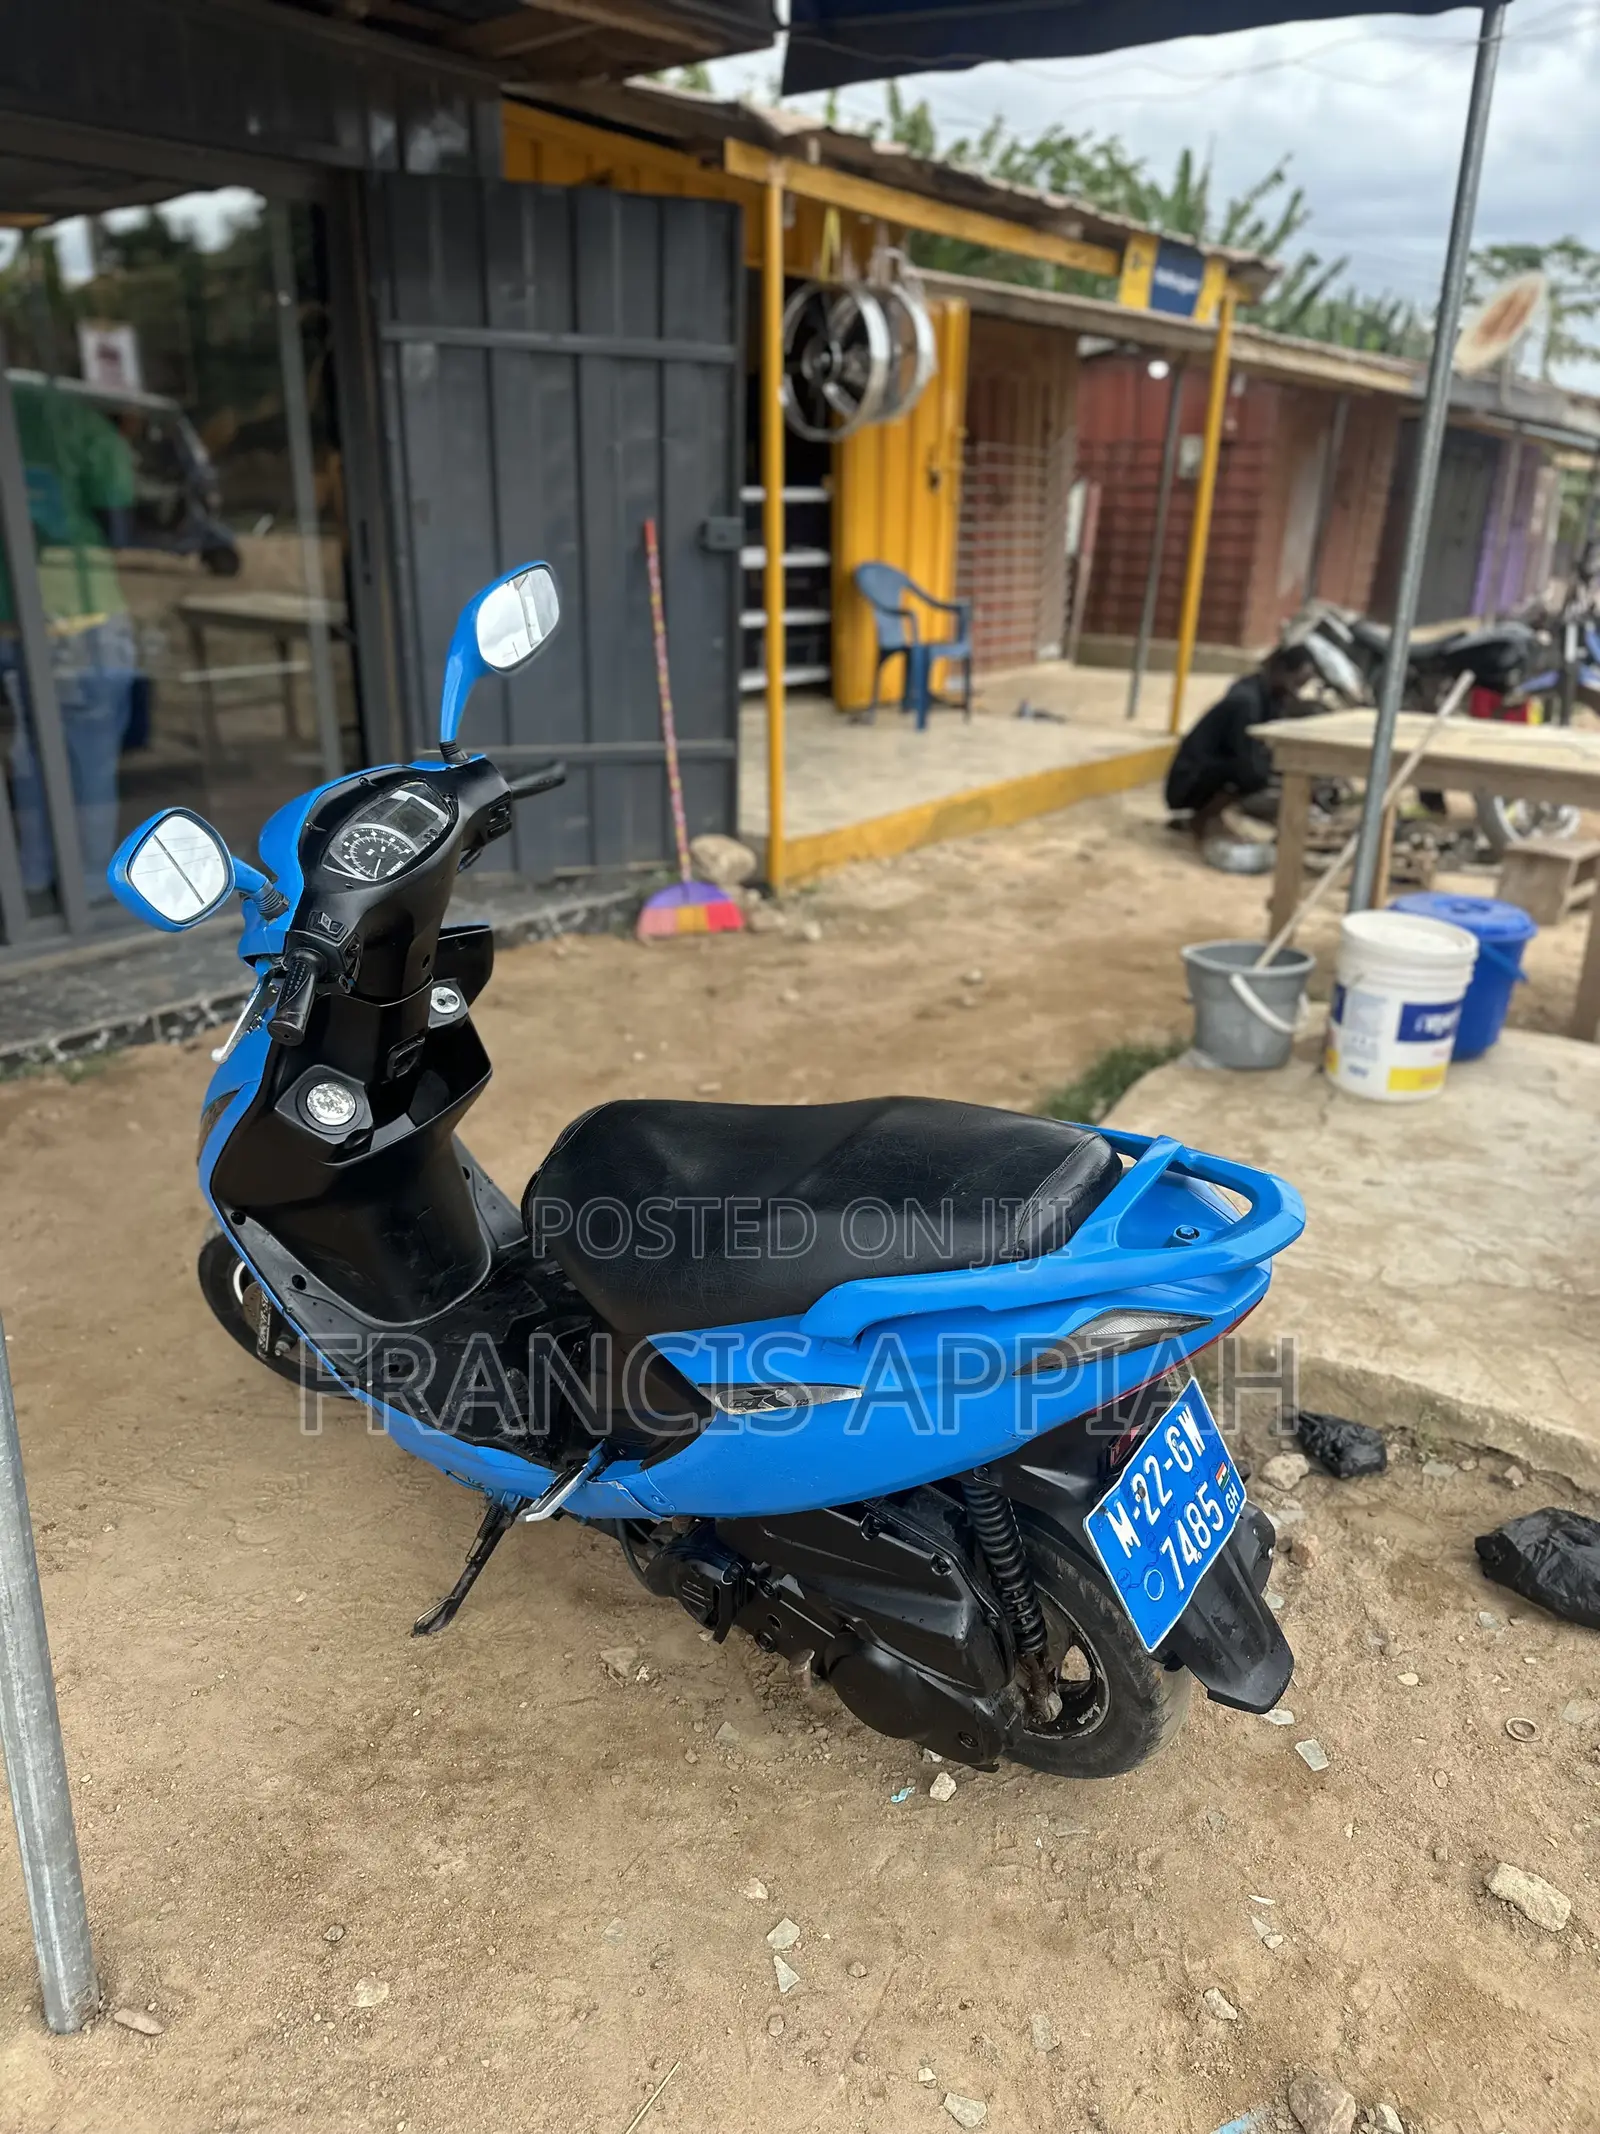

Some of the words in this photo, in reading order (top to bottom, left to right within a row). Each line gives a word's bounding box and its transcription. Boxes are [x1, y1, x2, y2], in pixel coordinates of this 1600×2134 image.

[1104, 1405, 1206, 1559] M-22-GW
[1160, 1481, 1224, 1592] 7485
[1225, 1486, 1241, 1515] GH
